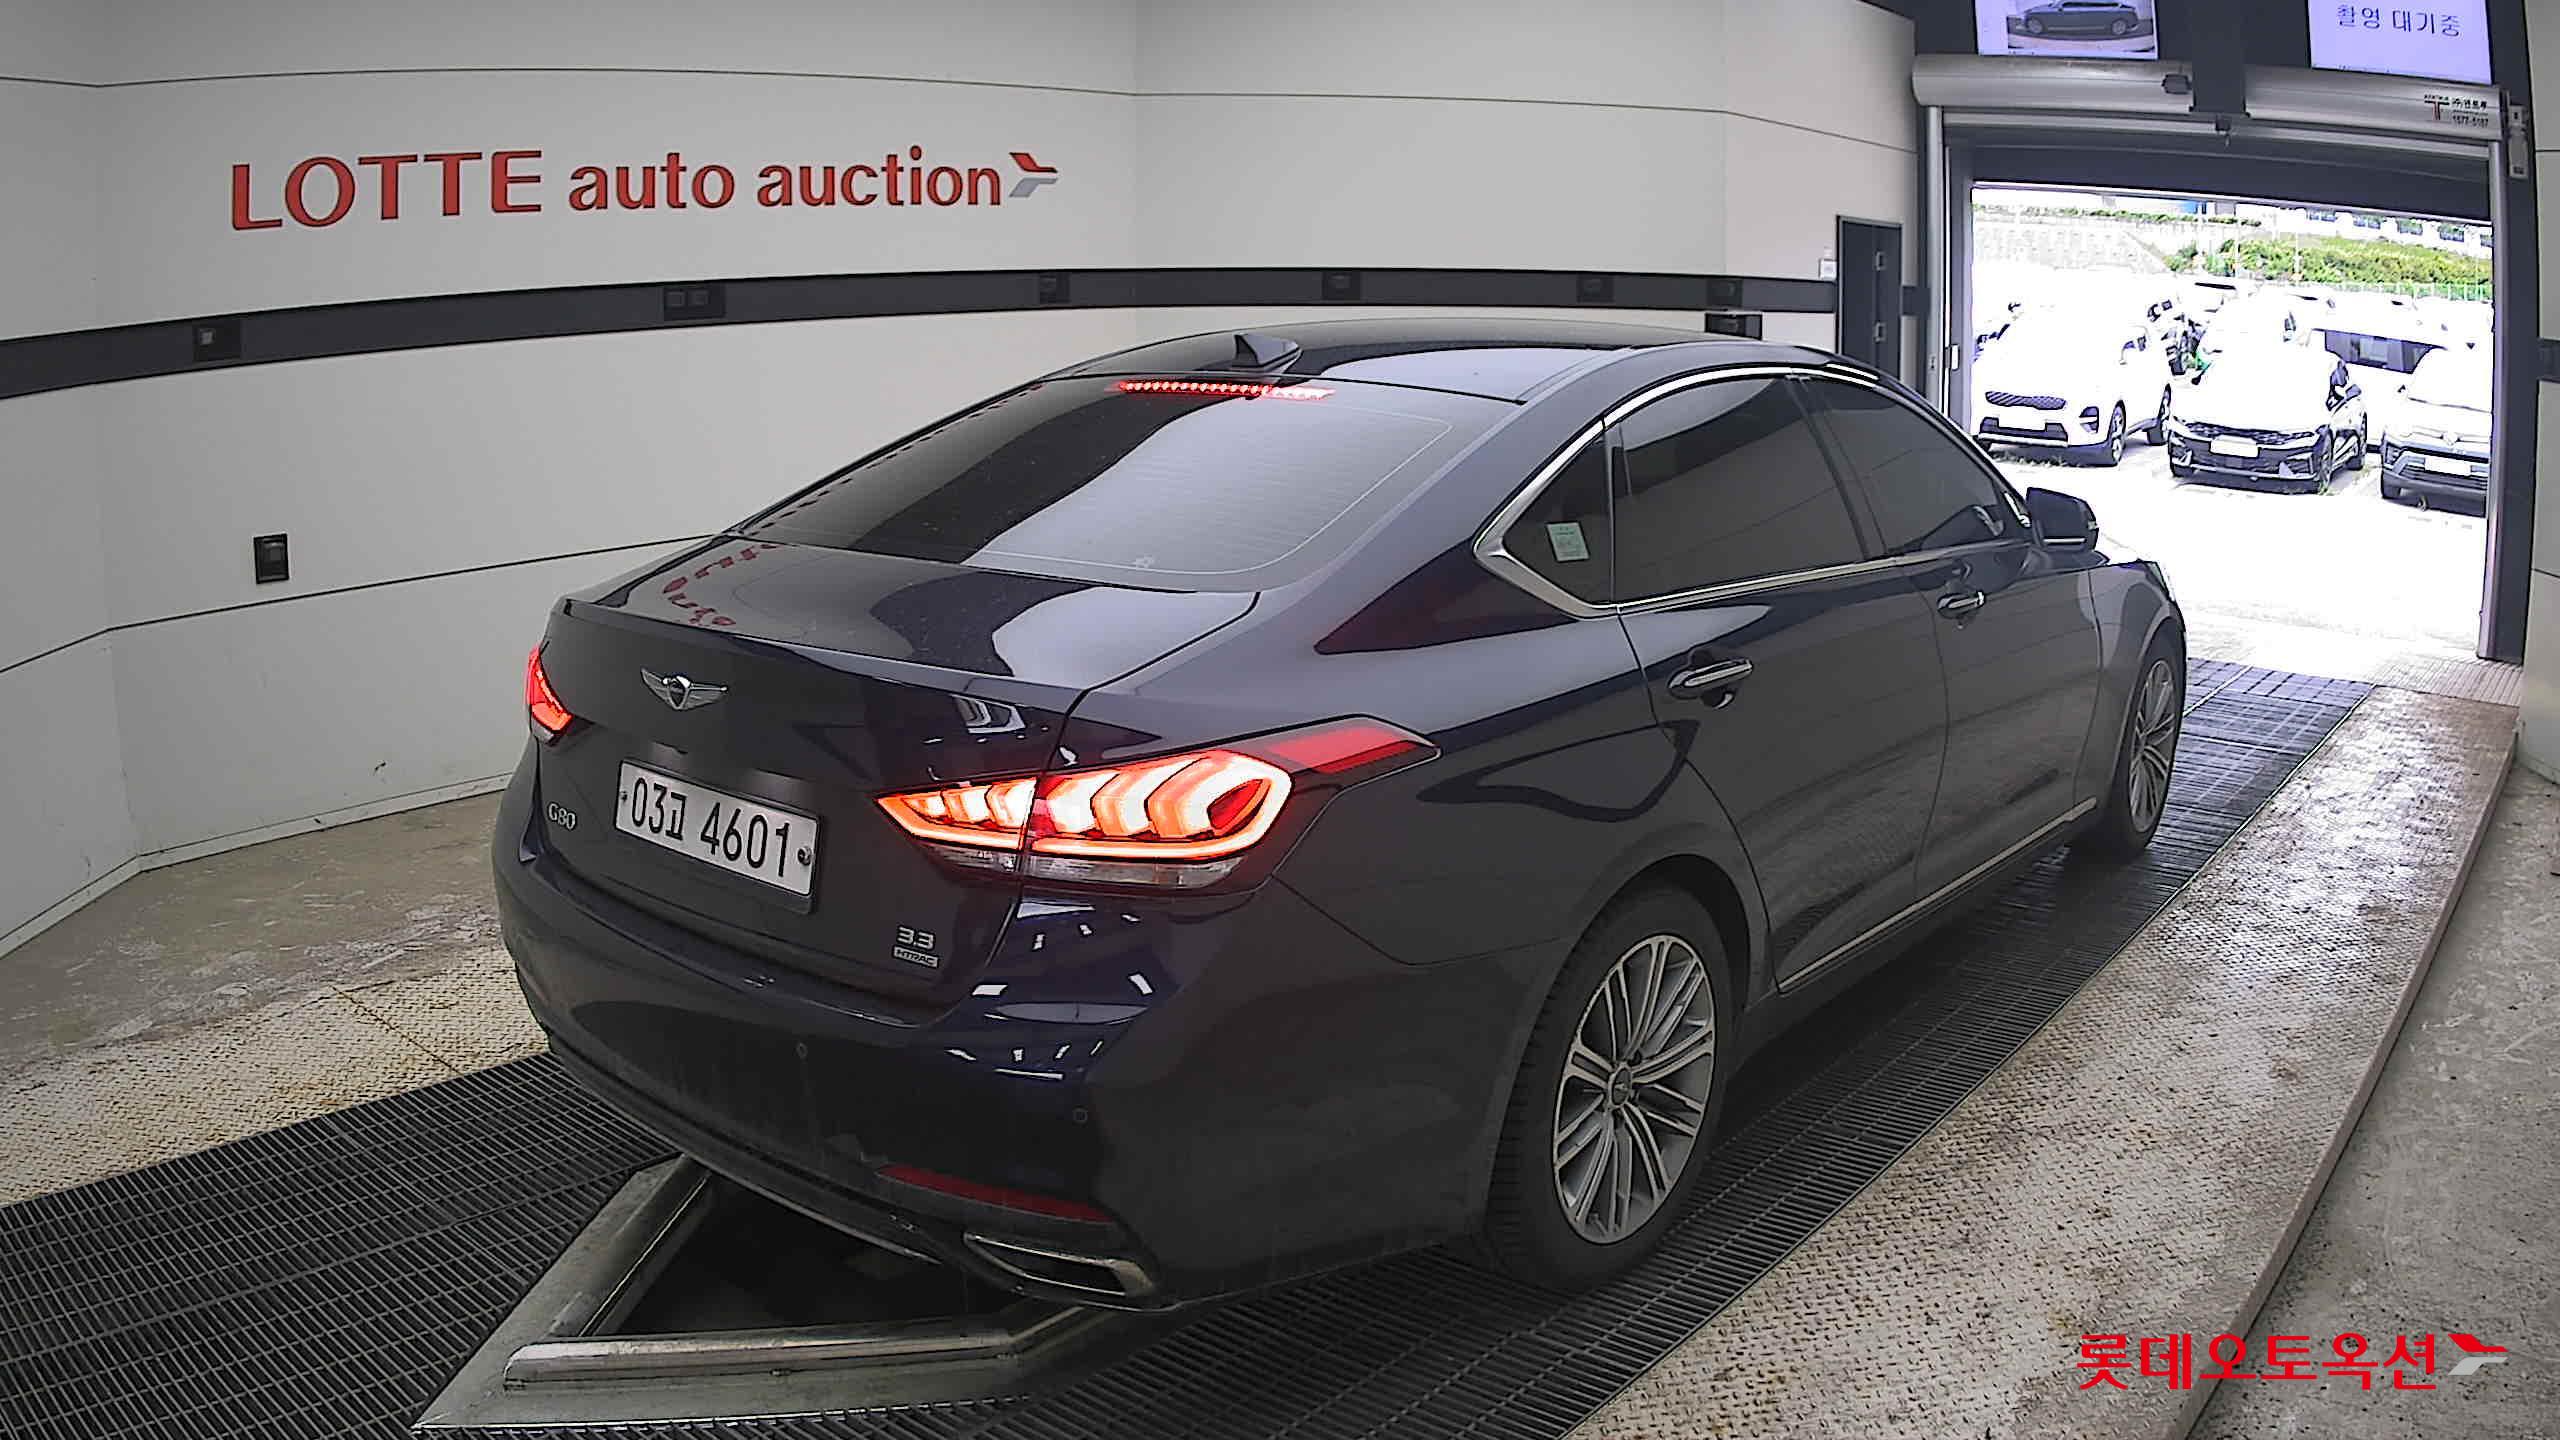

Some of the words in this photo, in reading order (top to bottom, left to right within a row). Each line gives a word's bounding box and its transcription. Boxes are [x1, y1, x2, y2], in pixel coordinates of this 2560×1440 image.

[2337, 4, 2380, 29] 촬영
[2391, 9, 2460, 37] 대기중
[231, 150, 543, 231] LOTTE
[568, 152, 736, 210] auto
[756, 145, 1001, 208] auction
[548, 802, 577, 830] G80
[631, 777, 688, 841] 03고
[700, 801, 790, 878] 4601
[897, 925, 934, 950] 3.3
